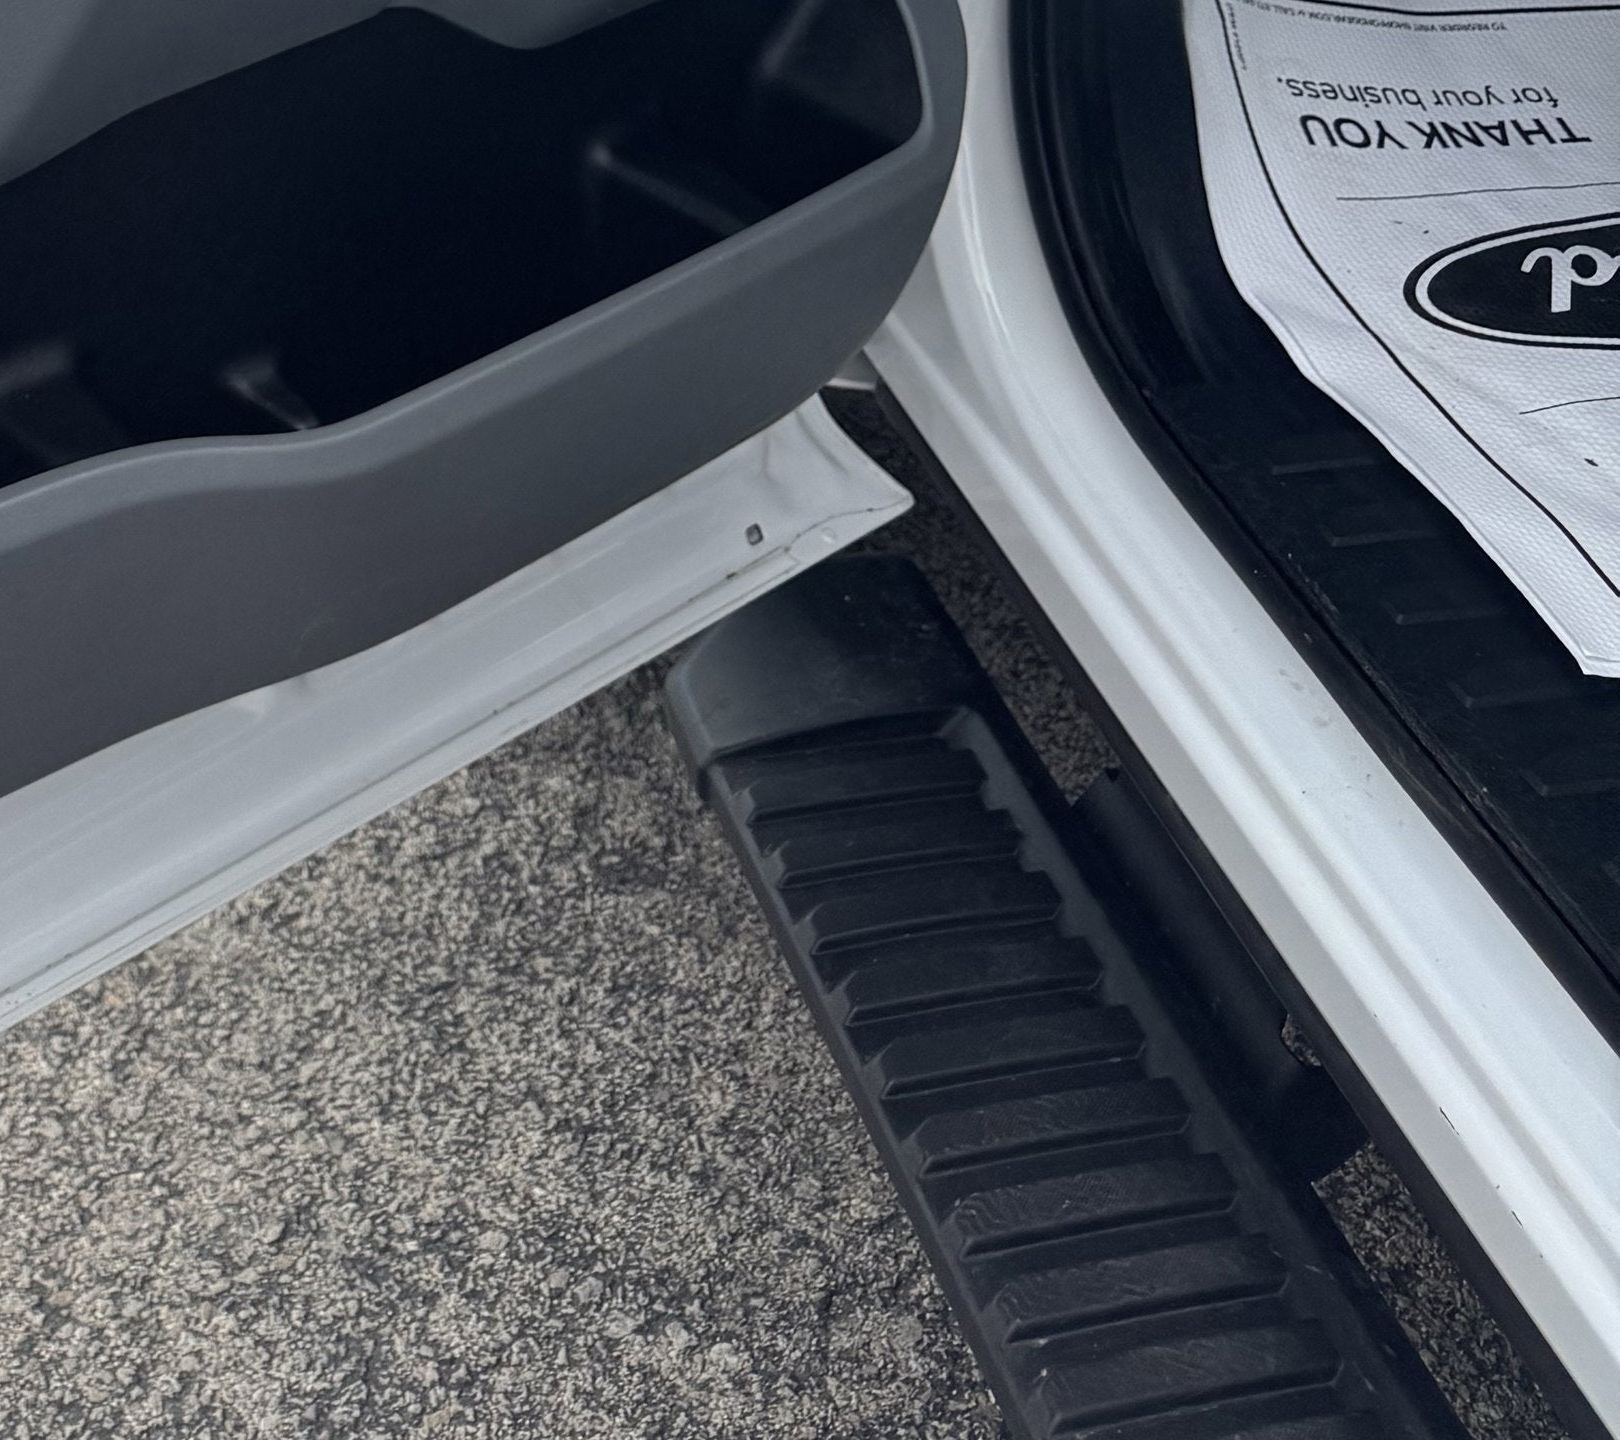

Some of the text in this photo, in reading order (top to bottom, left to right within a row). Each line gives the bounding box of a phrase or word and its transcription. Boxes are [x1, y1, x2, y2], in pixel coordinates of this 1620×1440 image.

[1276, 77, 1559, 111] for your business.
[1298, 114, 1593, 150] THANK YOU
